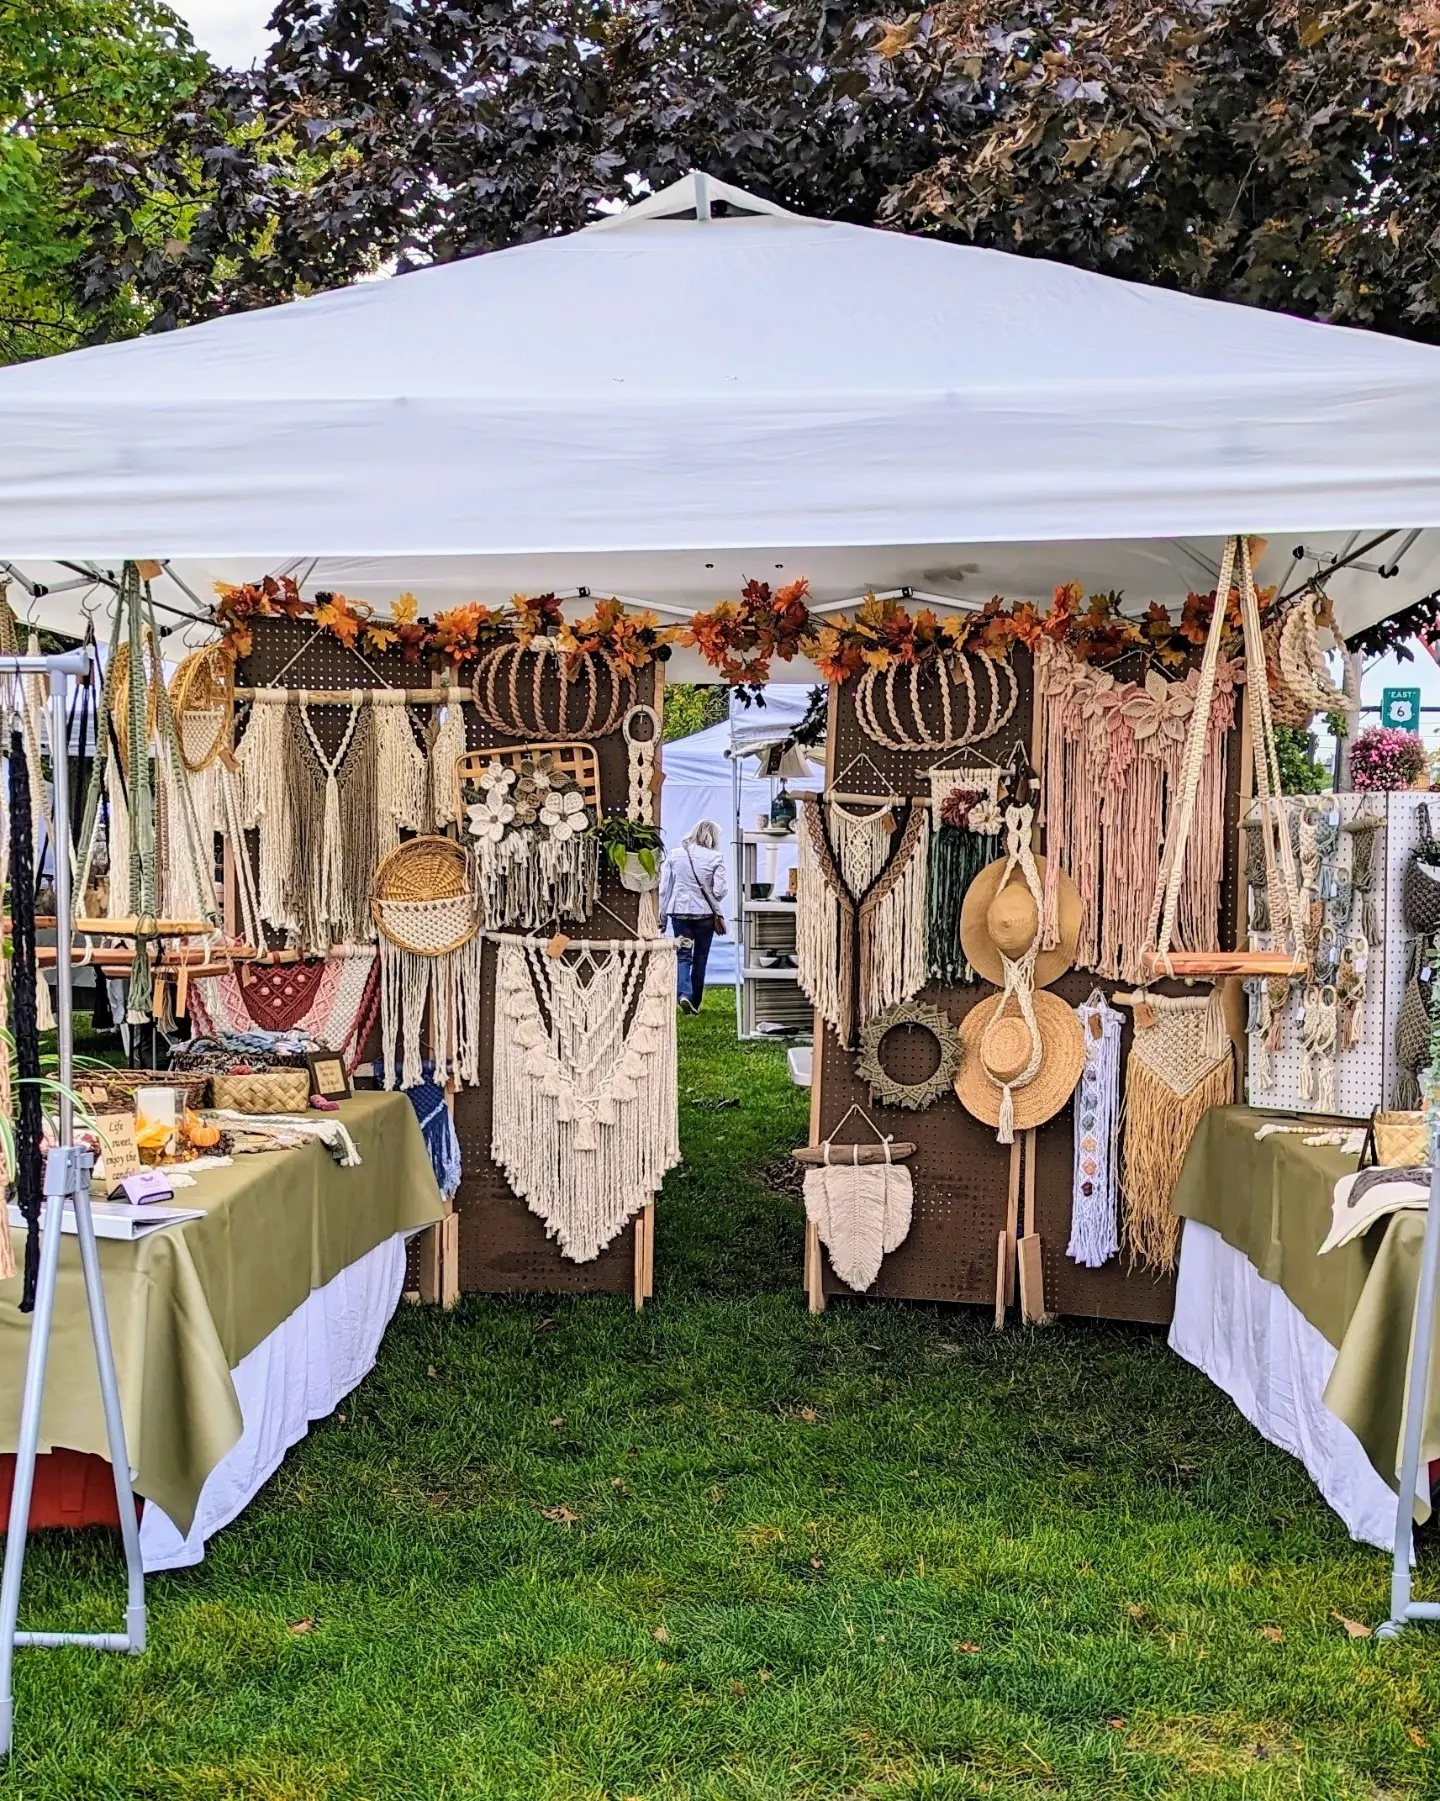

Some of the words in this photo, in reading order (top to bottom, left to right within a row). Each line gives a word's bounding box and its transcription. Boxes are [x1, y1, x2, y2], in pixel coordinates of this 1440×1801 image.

[1397, 706, 1405, 717] 6
[109, 1120, 124, 1134] Life
[106, 1154, 124, 1167] enjoy
[125, 1151, 137, 1162] the
